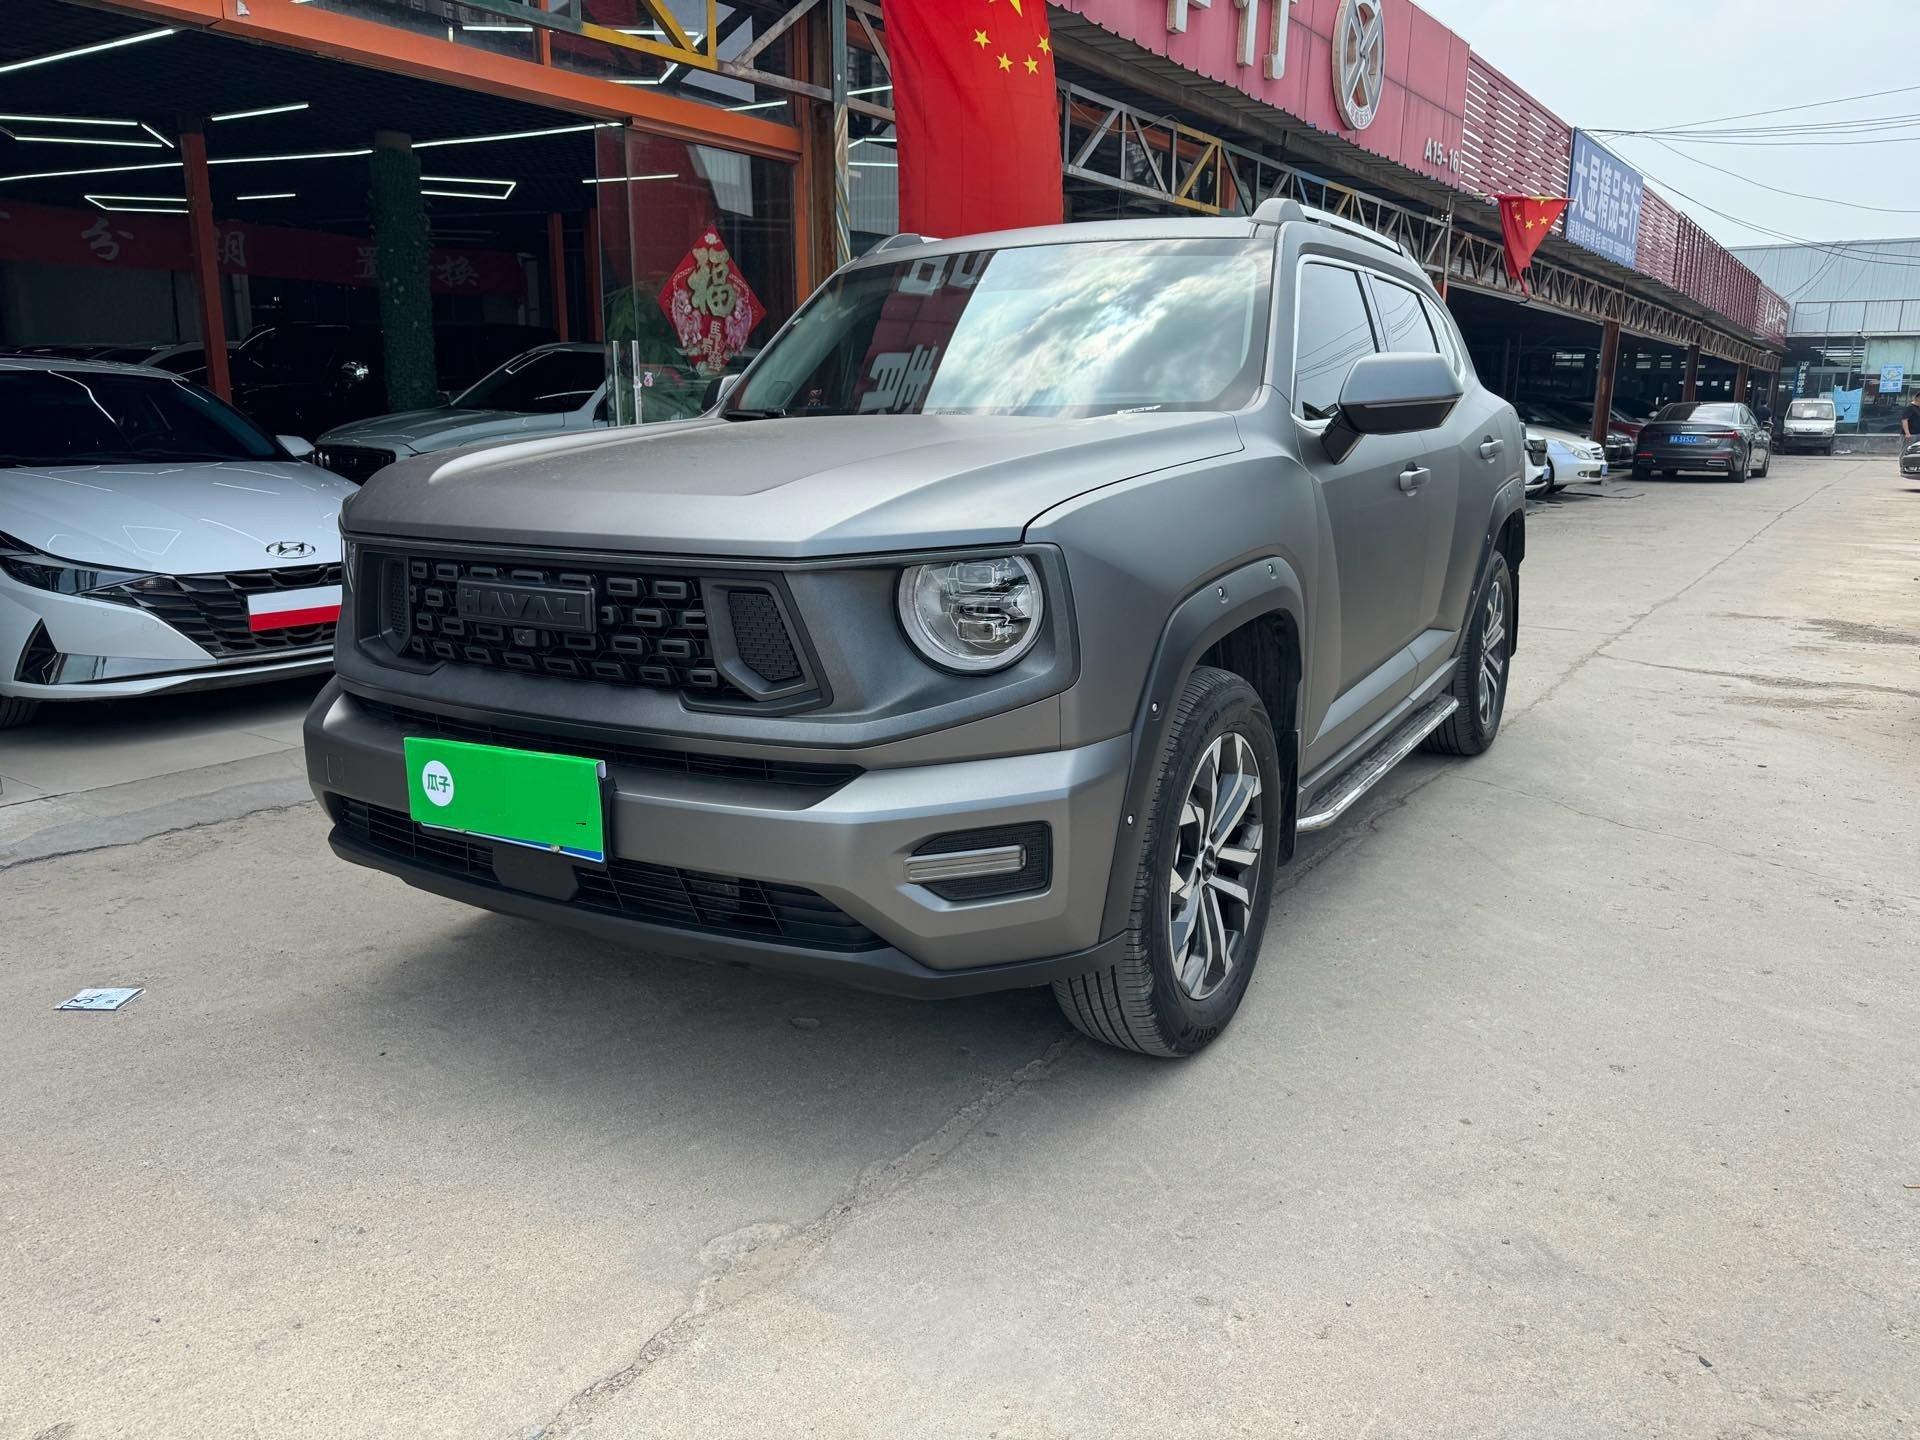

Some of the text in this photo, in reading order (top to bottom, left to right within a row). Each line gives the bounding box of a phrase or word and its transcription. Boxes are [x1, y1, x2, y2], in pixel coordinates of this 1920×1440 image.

[1424, 136, 1460, 174] A15-16
[687, 246, 737, 318] 福
[460, 587, 585, 628] HAVAL
